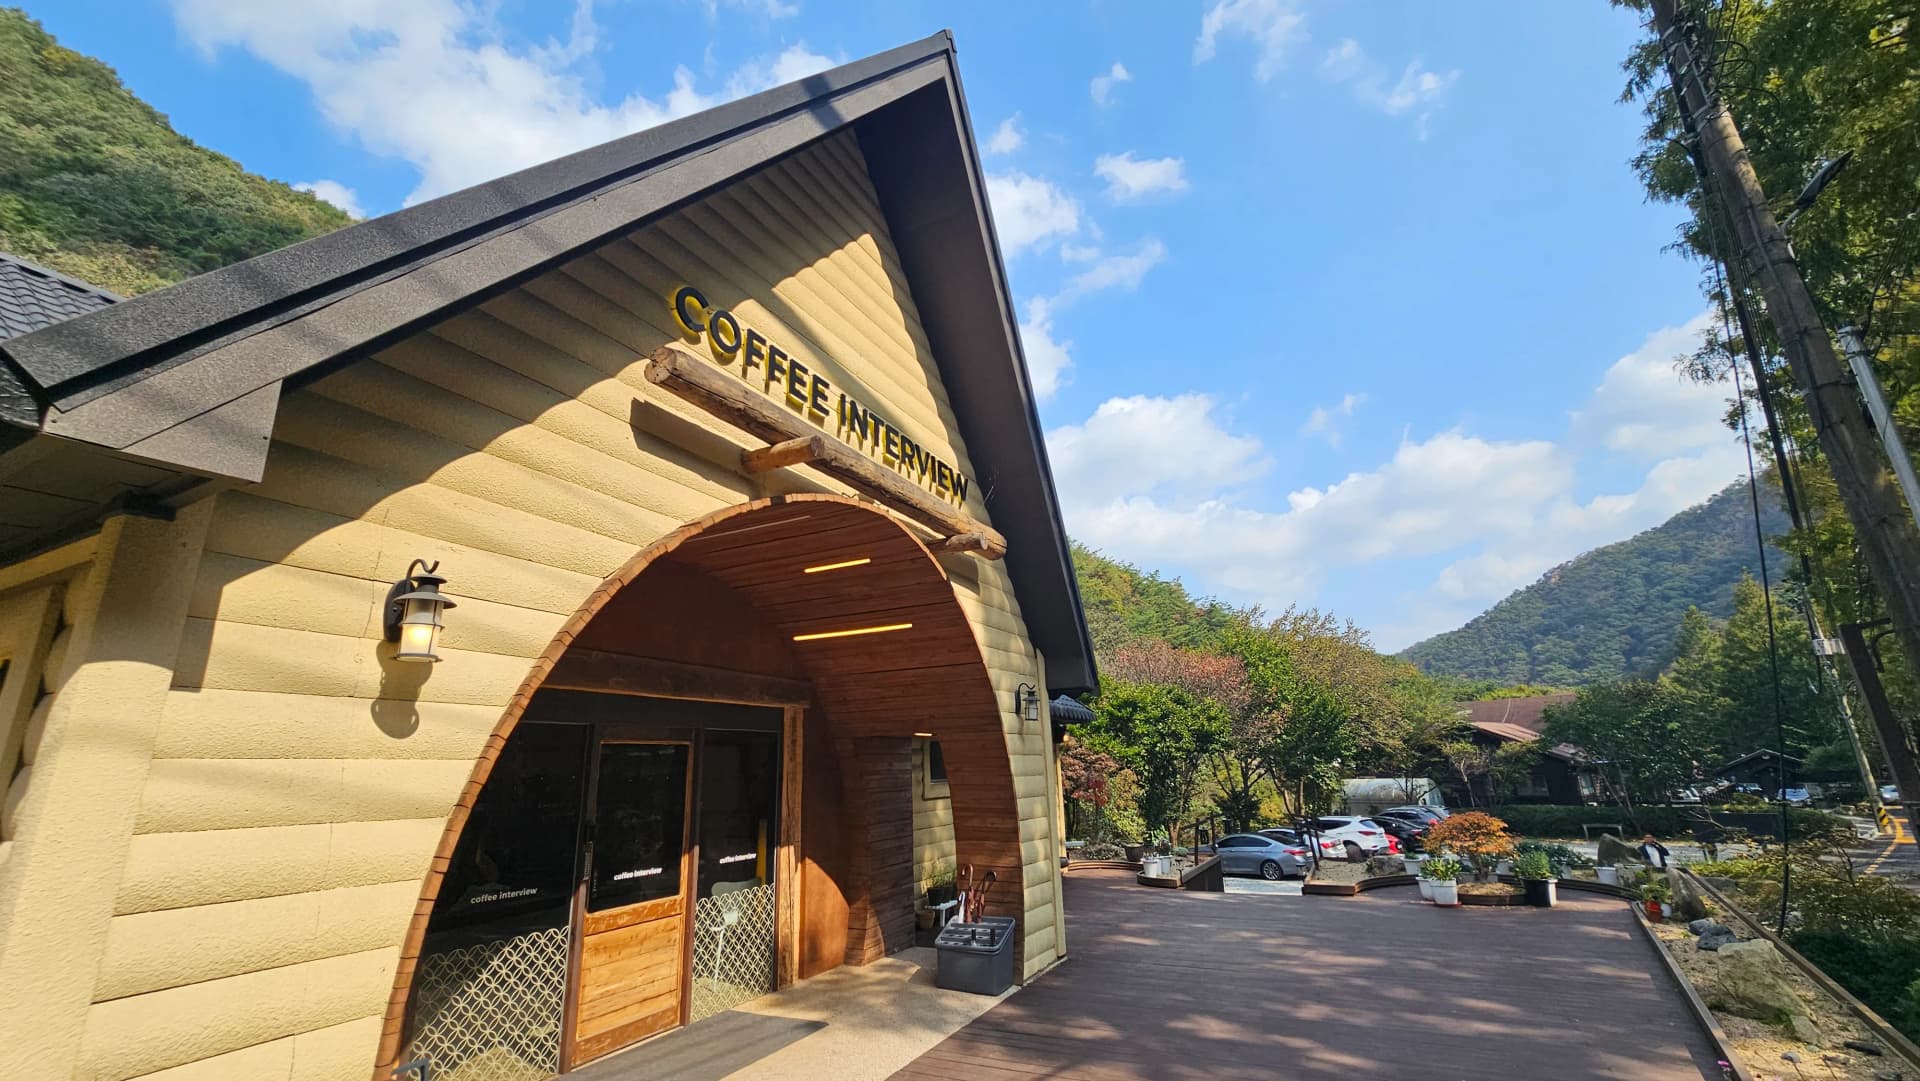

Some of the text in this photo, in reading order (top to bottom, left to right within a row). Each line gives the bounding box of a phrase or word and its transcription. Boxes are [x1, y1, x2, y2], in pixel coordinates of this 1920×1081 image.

[674, 286, 969, 502] COFFEE INTERVIEW
[614, 867, 662, 881] coffee interview
[470, 888, 538, 904] coffee interview
